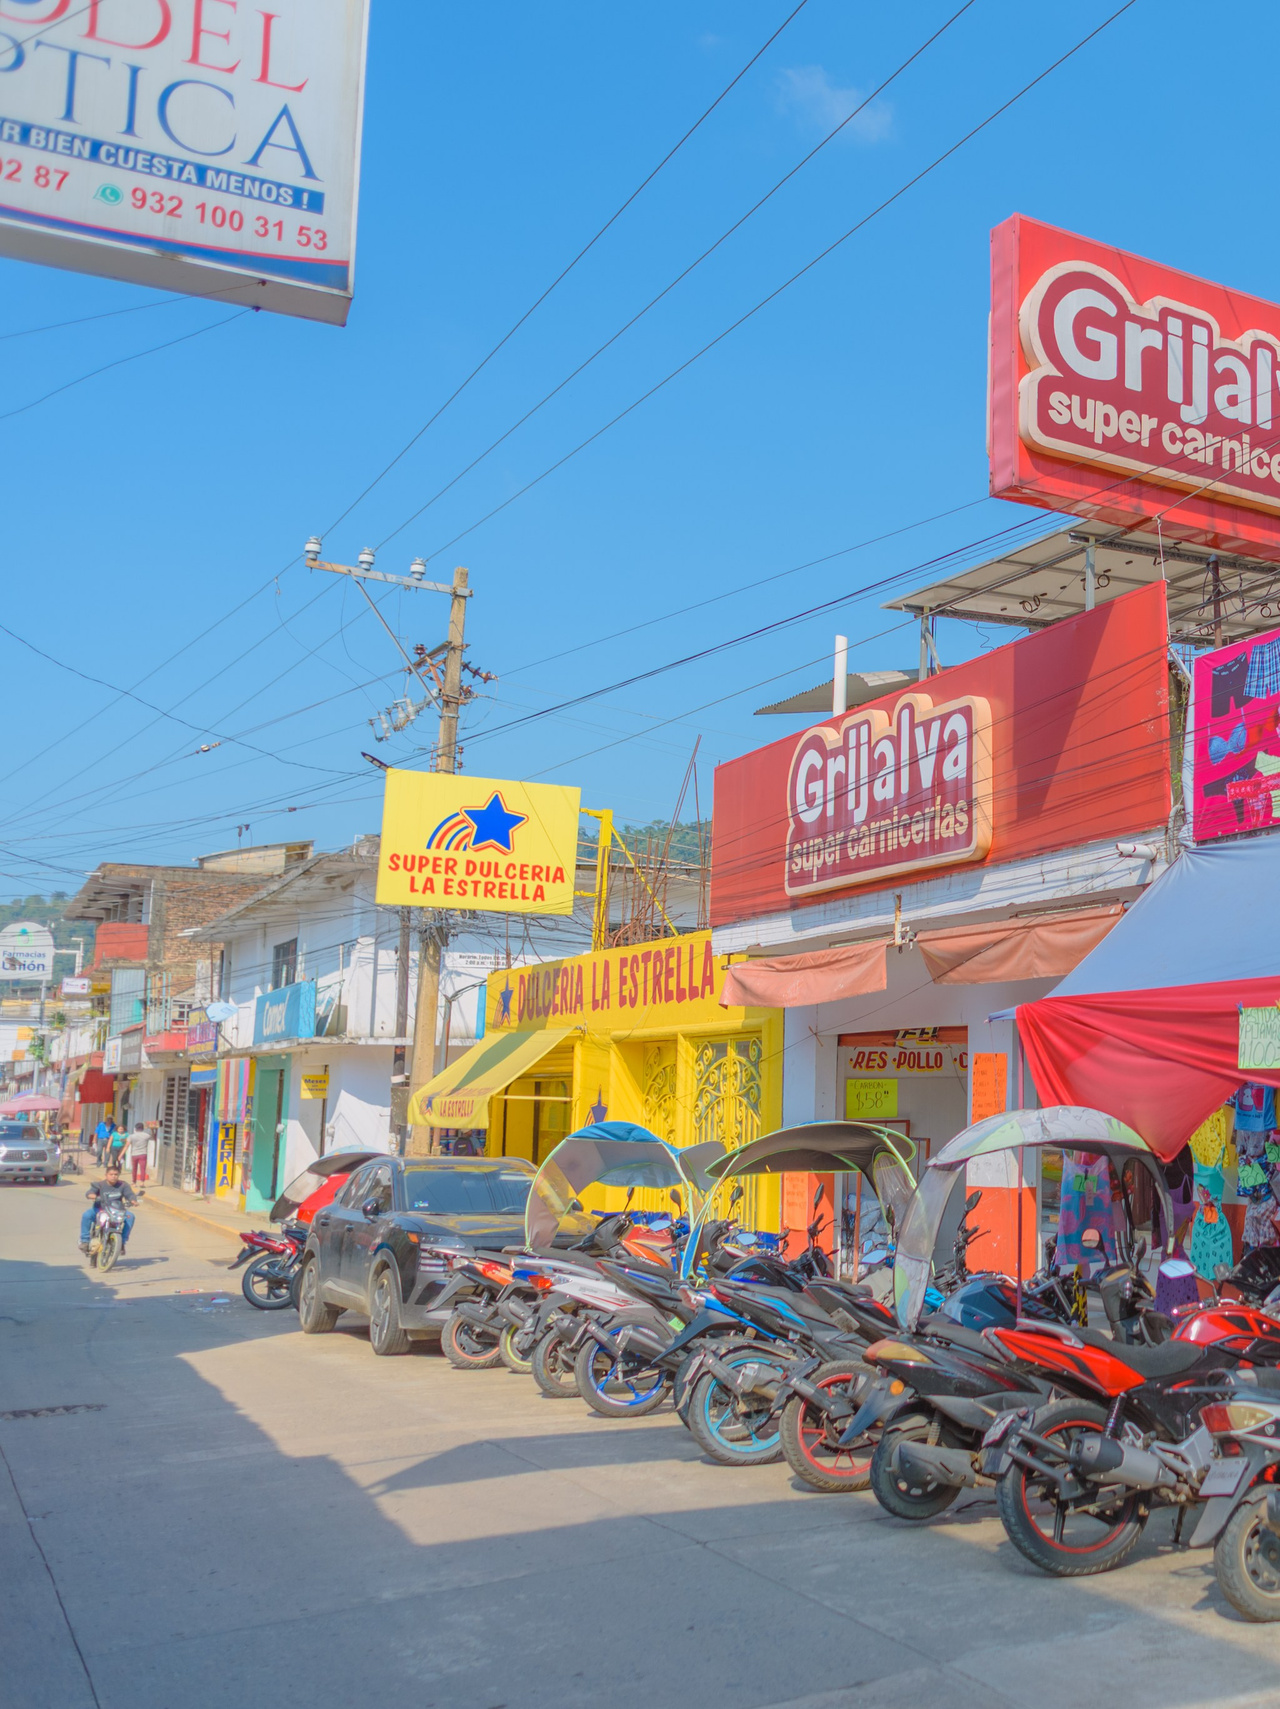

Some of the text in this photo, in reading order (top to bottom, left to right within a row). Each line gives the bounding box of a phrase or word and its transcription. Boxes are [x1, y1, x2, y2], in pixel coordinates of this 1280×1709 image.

[29, 127, 91, 159] BIEN
[99, 143, 198, 184] CUESTA
[206, 171, 294, 207] MENOS
[33, 165, 70, 193] 87
[130, 187, 183, 219] 932
[195, 202, 244, 232] 100
[254, 215, 285, 243] 31
[296, 225, 329, 251] 53
[1048, 391, 1159, 444] super
[796, 708, 968, 824] Grijalva
[388, 853, 566, 884] SUPER DULCERIA
[791, 831, 844, 882] super
[409, 875, 546, 902] LA ESTRELLA
[2, 950, 46, 959] Farmacias
[518, 940, 715, 1023] DULCERIA LA ESTRELLA
[853, 1050, 888, 1070] RES
[896, 1050, 943, 1070] POLLO
[440, 1099, 447, 1118] LA
